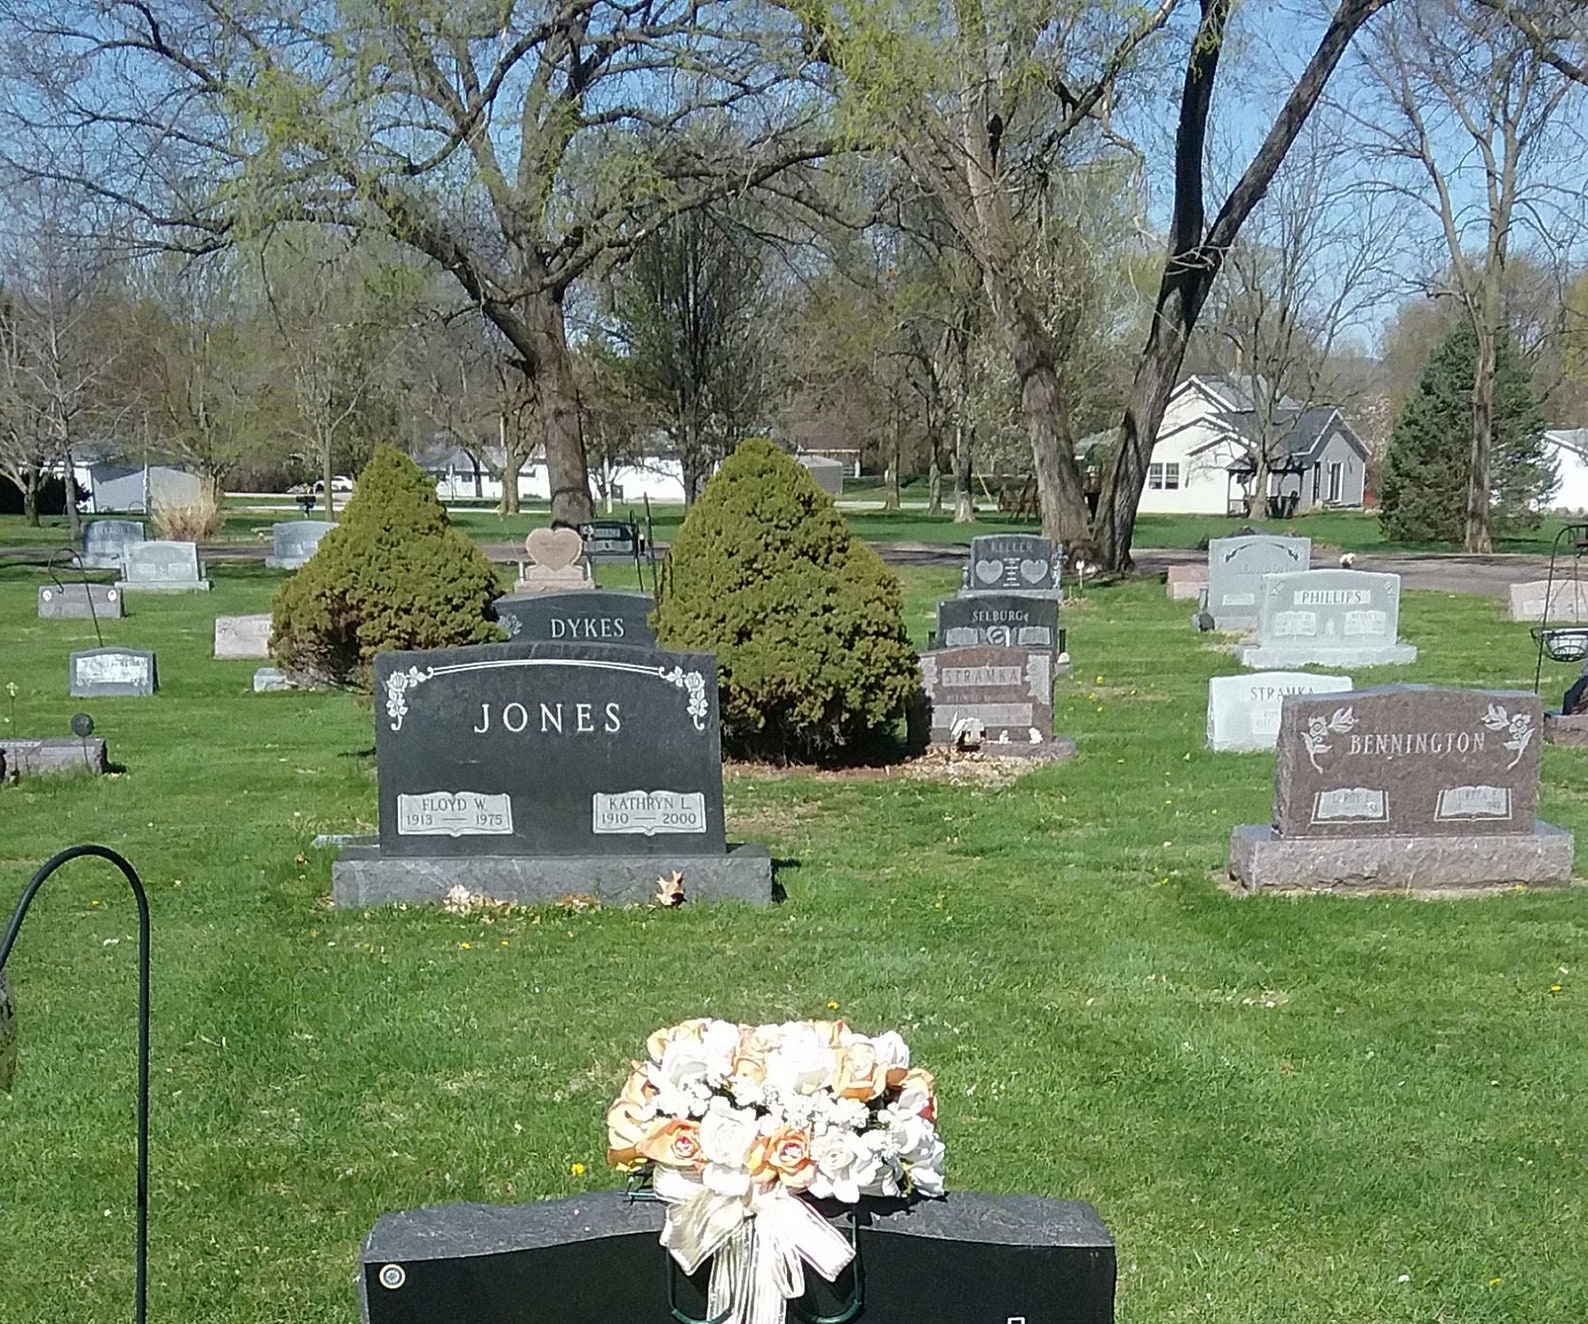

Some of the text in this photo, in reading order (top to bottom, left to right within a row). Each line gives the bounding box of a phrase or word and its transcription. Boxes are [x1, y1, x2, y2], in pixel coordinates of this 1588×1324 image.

[1301, 591, 1362, 604] PHILLIPS
[550, 617, 625, 638] DYKES
[944, 669, 1019, 684] STRAMKA
[473, 701, 623, 734] JONES
[1348, 731, 1486, 756] BENNINGTON
[421, 797, 468, 812] FLOYD
[608, 796, 675, 811] KATHRYN
[406, 813, 503, 827] 1913 1975
[601, 812, 697, 825] 1910 2000
